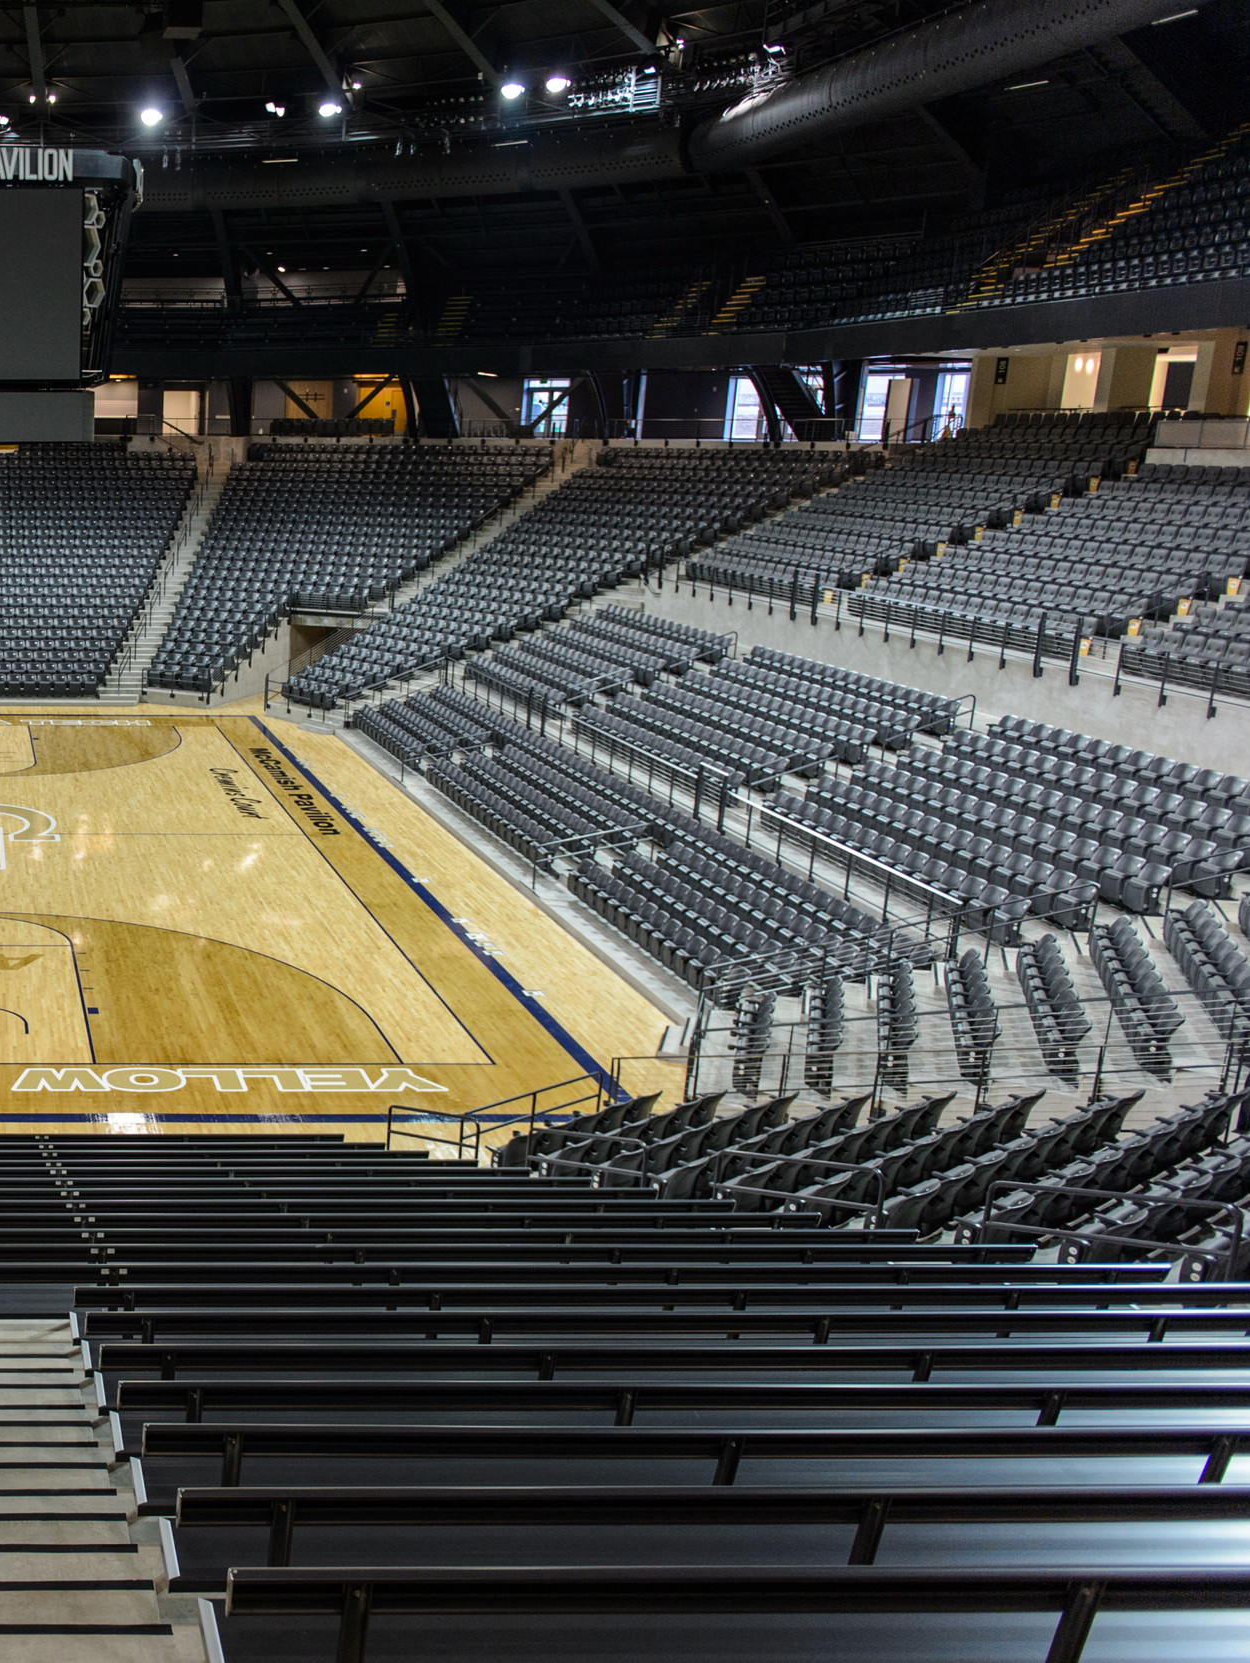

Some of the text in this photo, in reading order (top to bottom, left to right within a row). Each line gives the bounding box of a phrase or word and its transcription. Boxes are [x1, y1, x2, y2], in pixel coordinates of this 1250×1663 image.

[248, 747, 341, 836] McCamish Pavilion
[11, 1067, 450, 1093] YELLOW
